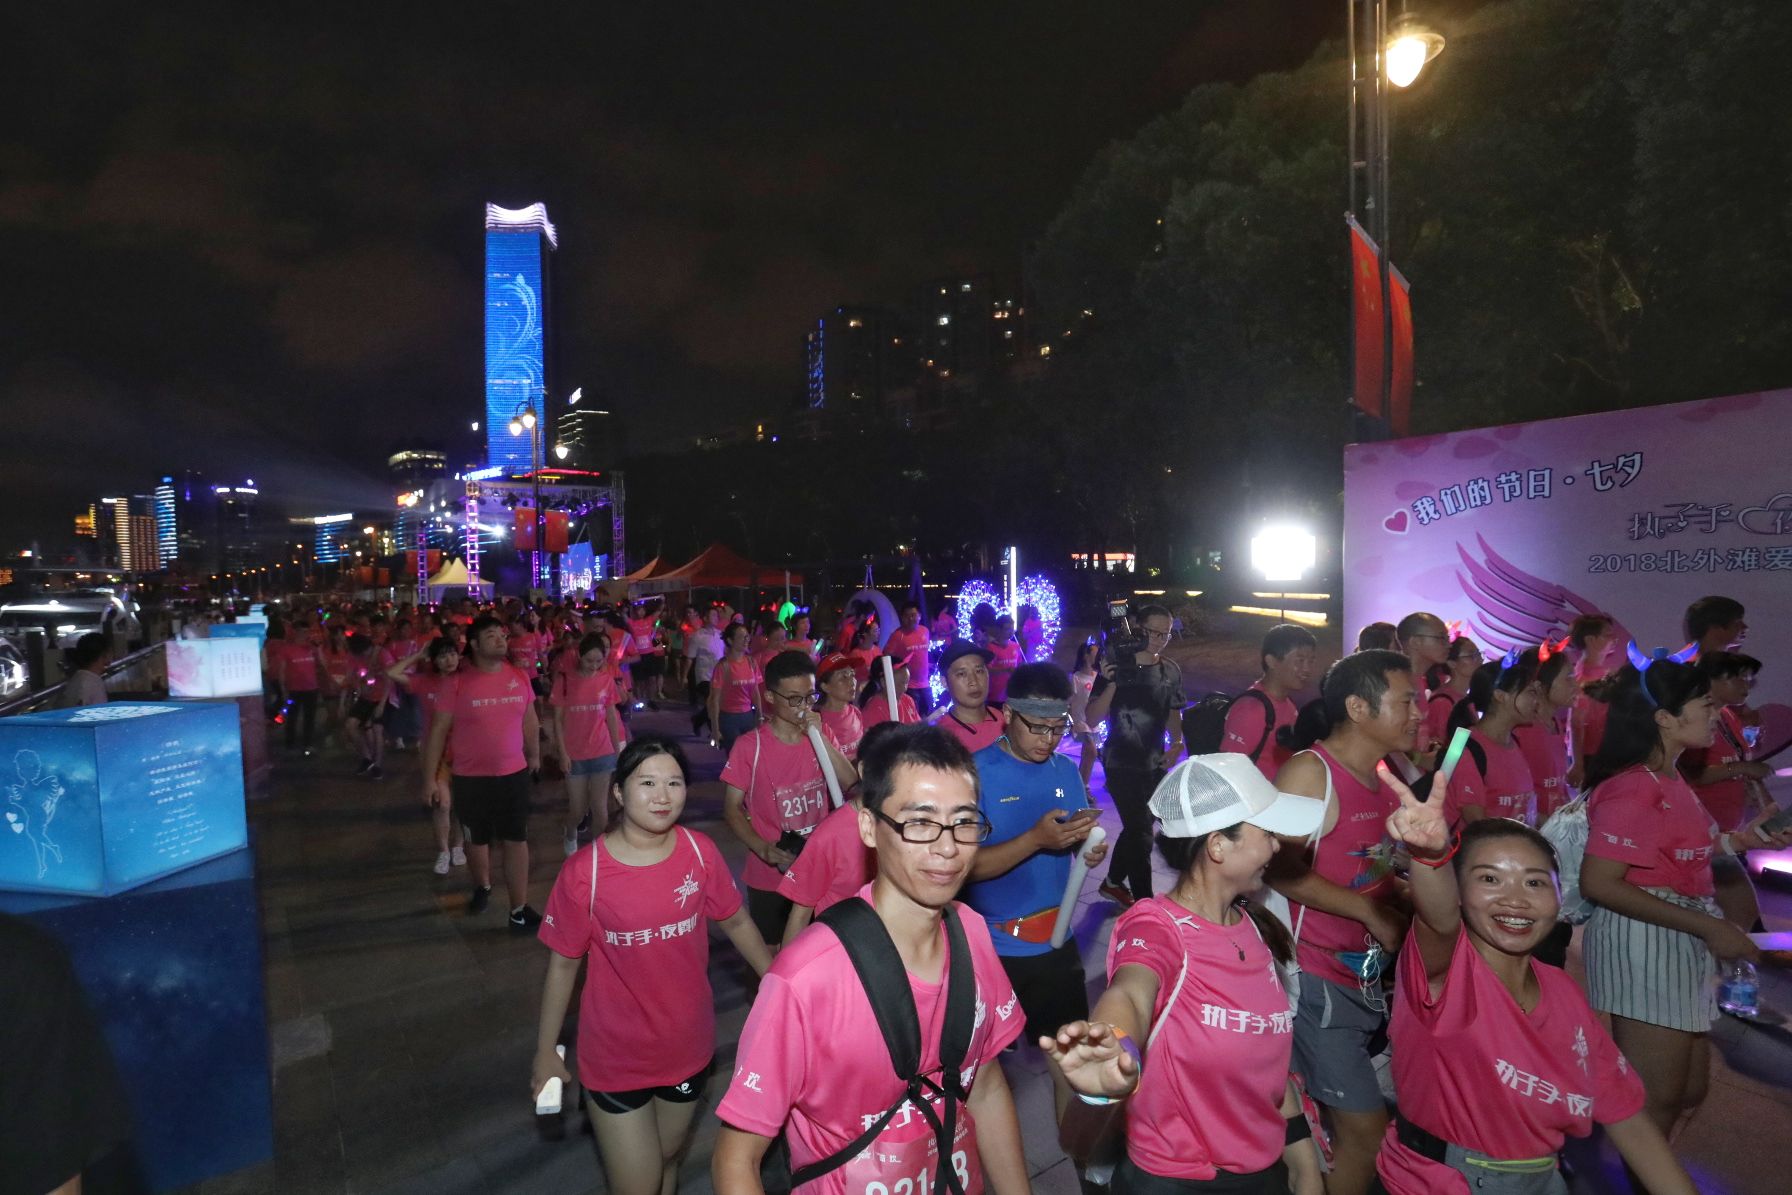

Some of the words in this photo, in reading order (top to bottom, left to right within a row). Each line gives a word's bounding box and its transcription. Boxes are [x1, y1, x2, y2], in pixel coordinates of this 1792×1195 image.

[1412, 452, 1643, 525] 我们的节日·七夕
[1588, 546, 1792, 574] 2018北外滩爱
[782, 790, 824, 818] 231-A
